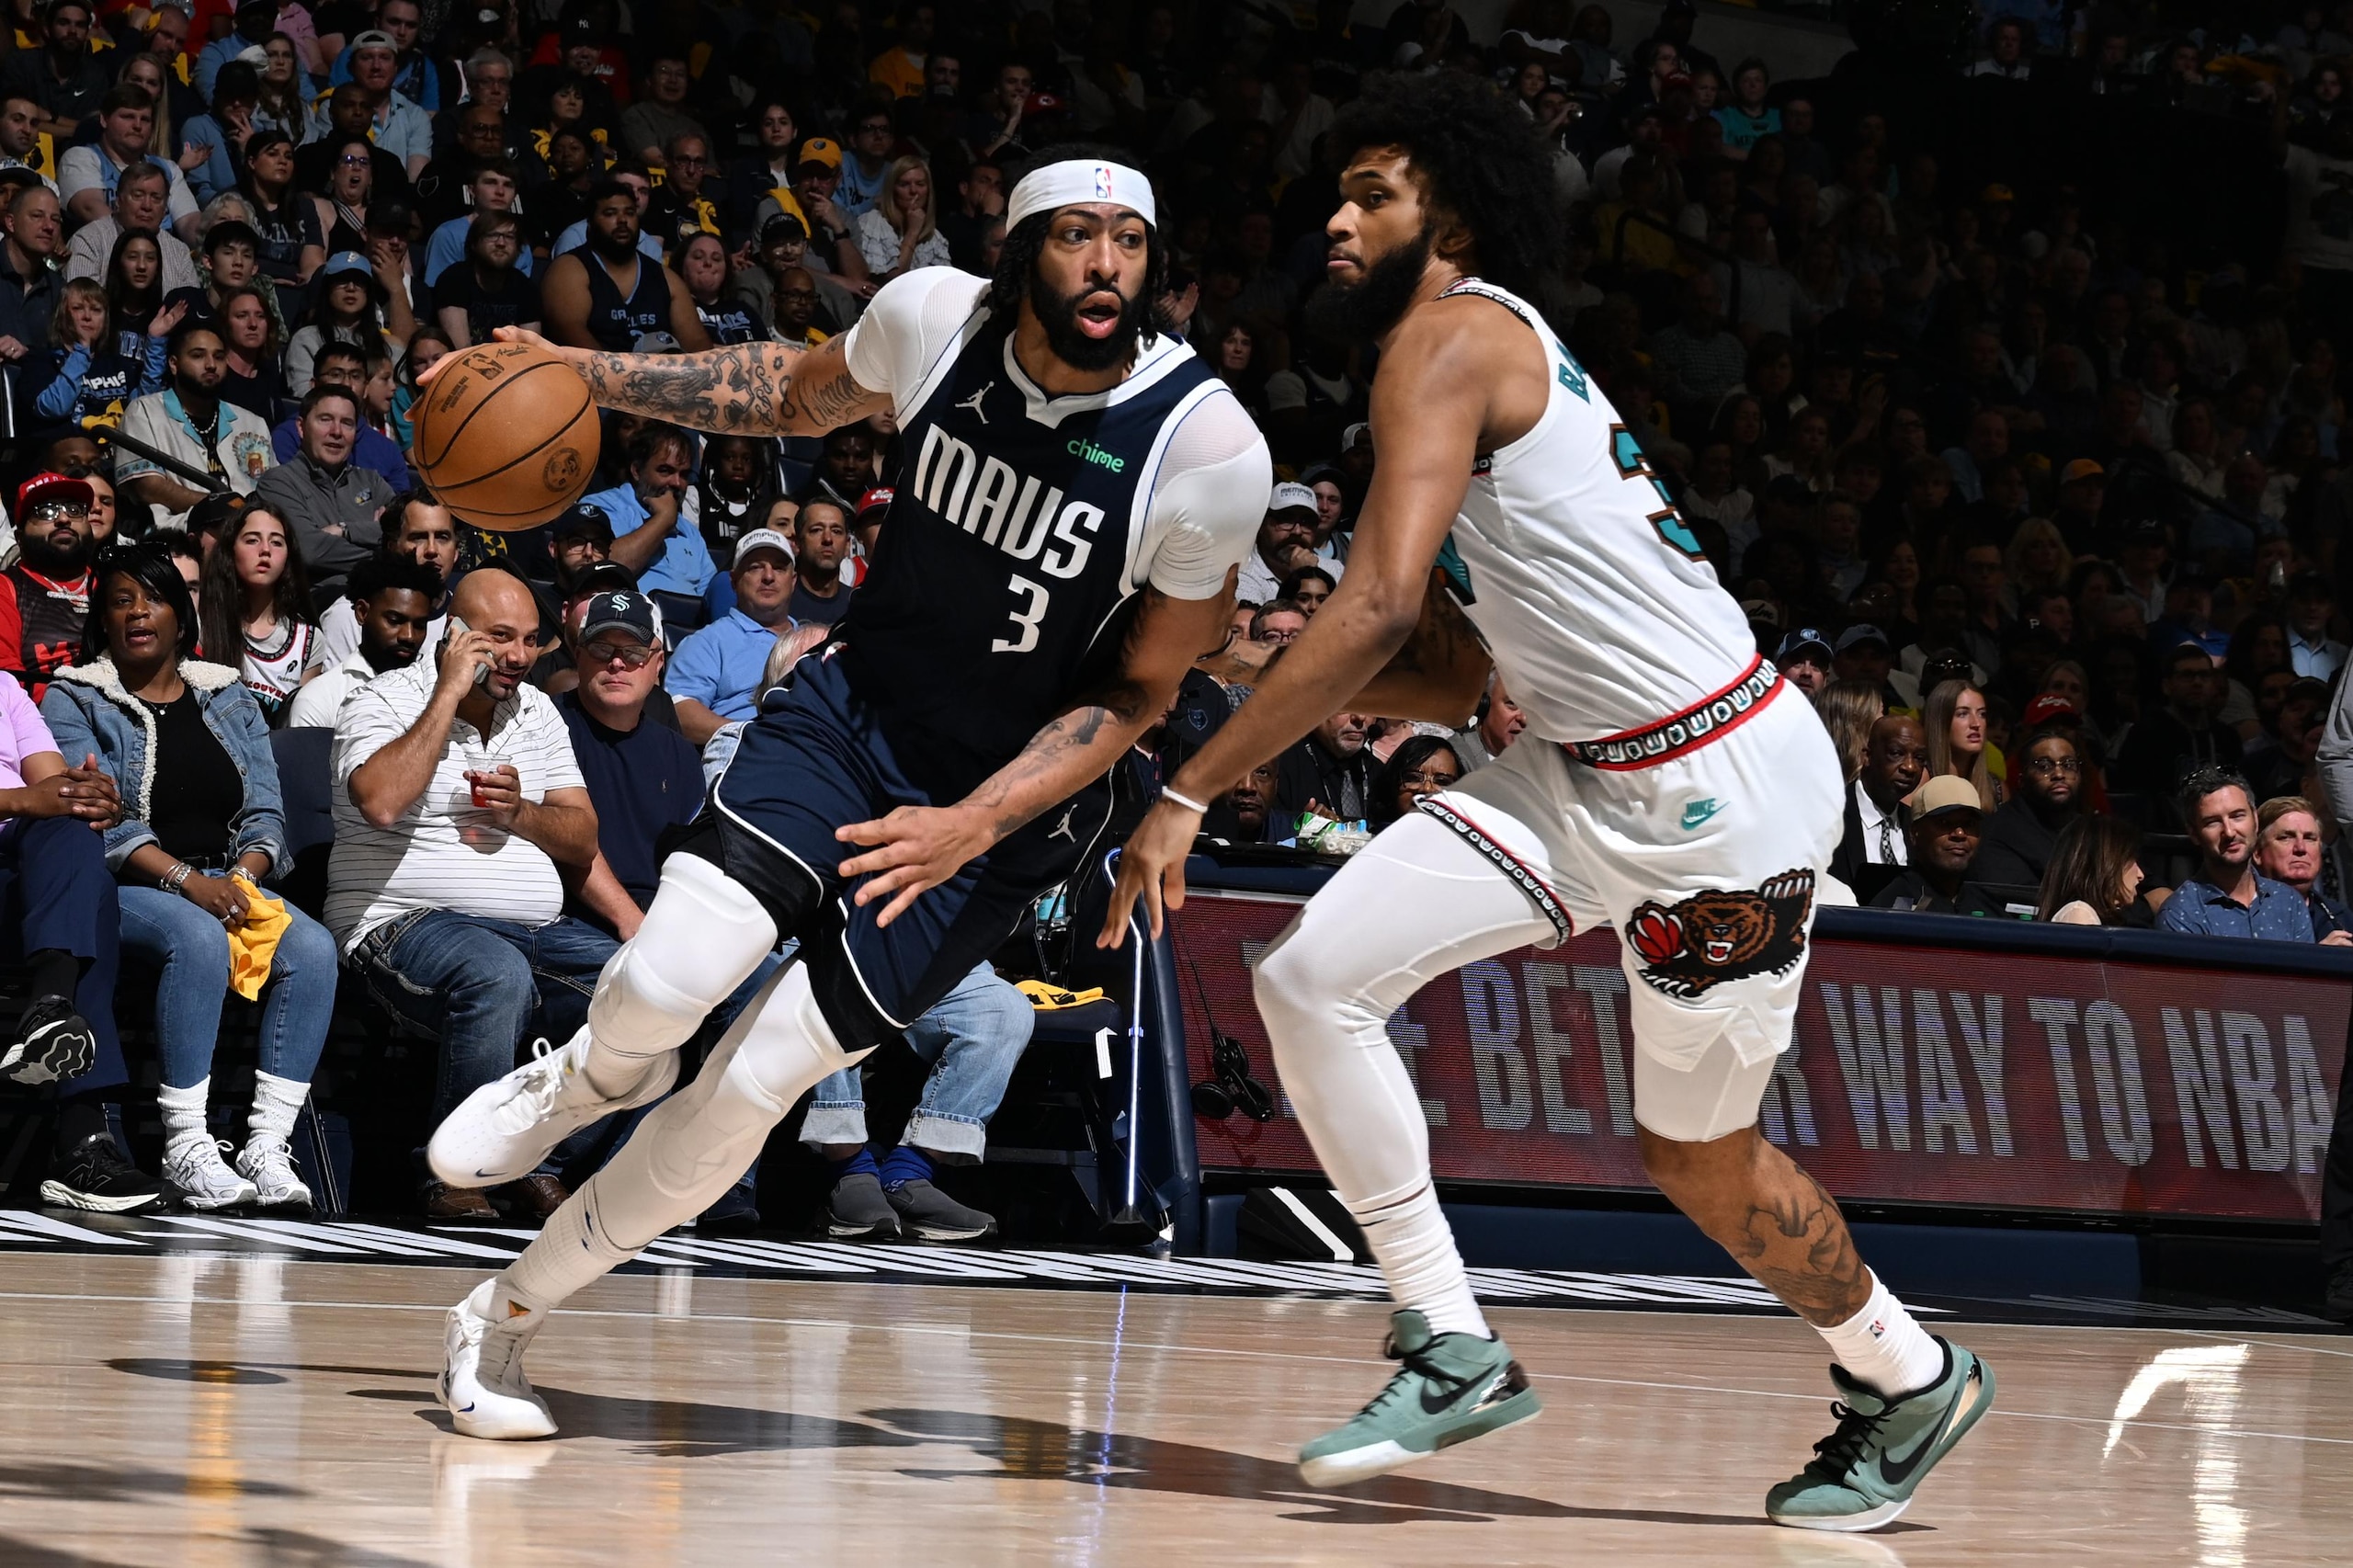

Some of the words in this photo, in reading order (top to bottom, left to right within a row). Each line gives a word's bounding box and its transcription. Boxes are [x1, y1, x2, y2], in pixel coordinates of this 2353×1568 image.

[1066, 437, 1125, 473] chime
[1280, 486, 1313, 499] MEMPHIS
[992, 573, 1050, 653] 3
[1686, 797, 1716, 818] NIKE
[1459, 960, 1821, 1147] BETR
[1820, 982, 2016, 1158] WAY
[2028, 995, 2154, 1167] TO
[2162, 1007, 2336, 1175] NBA
